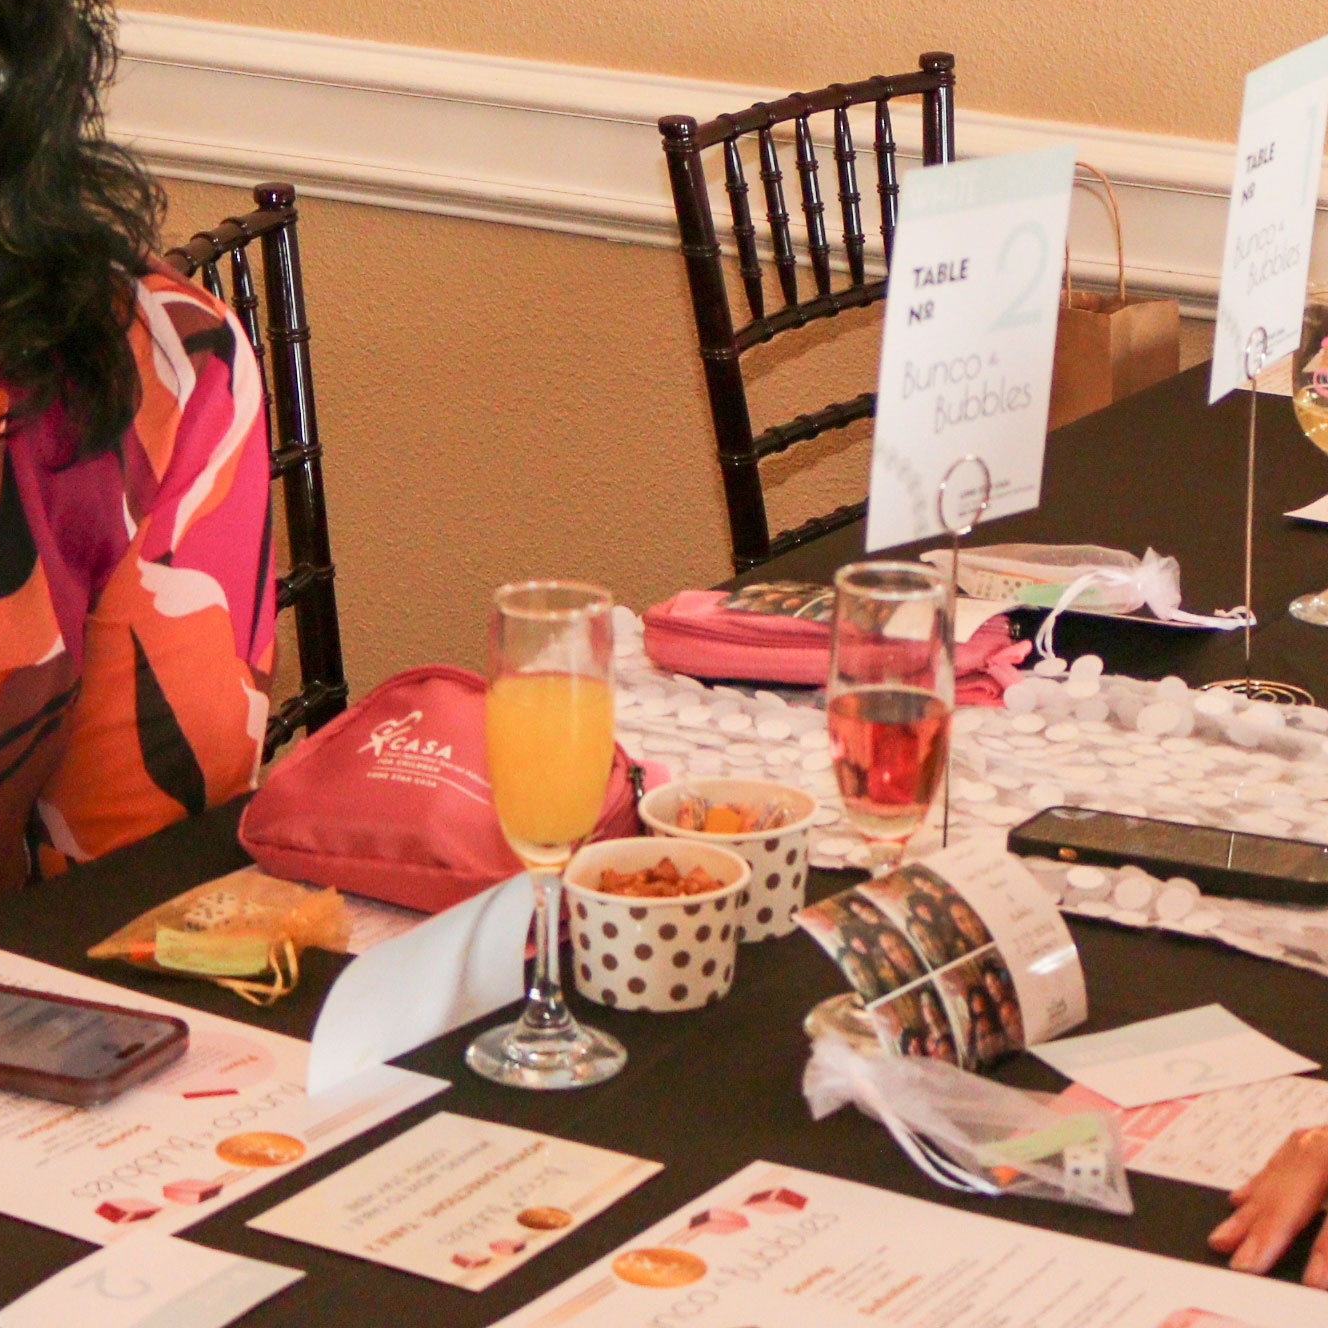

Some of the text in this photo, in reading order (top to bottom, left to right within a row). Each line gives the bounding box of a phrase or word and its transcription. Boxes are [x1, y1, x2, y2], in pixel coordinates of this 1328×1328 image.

[1246, 141, 1275, 174] TABLE
[912, 257, 971, 290] TABLE
[986, 219, 1049, 333] 2
[902, 352, 982, 401] Bunco
[934, 376, 1033, 435] Bubbles
[389, 736, 452, 759] CASA
